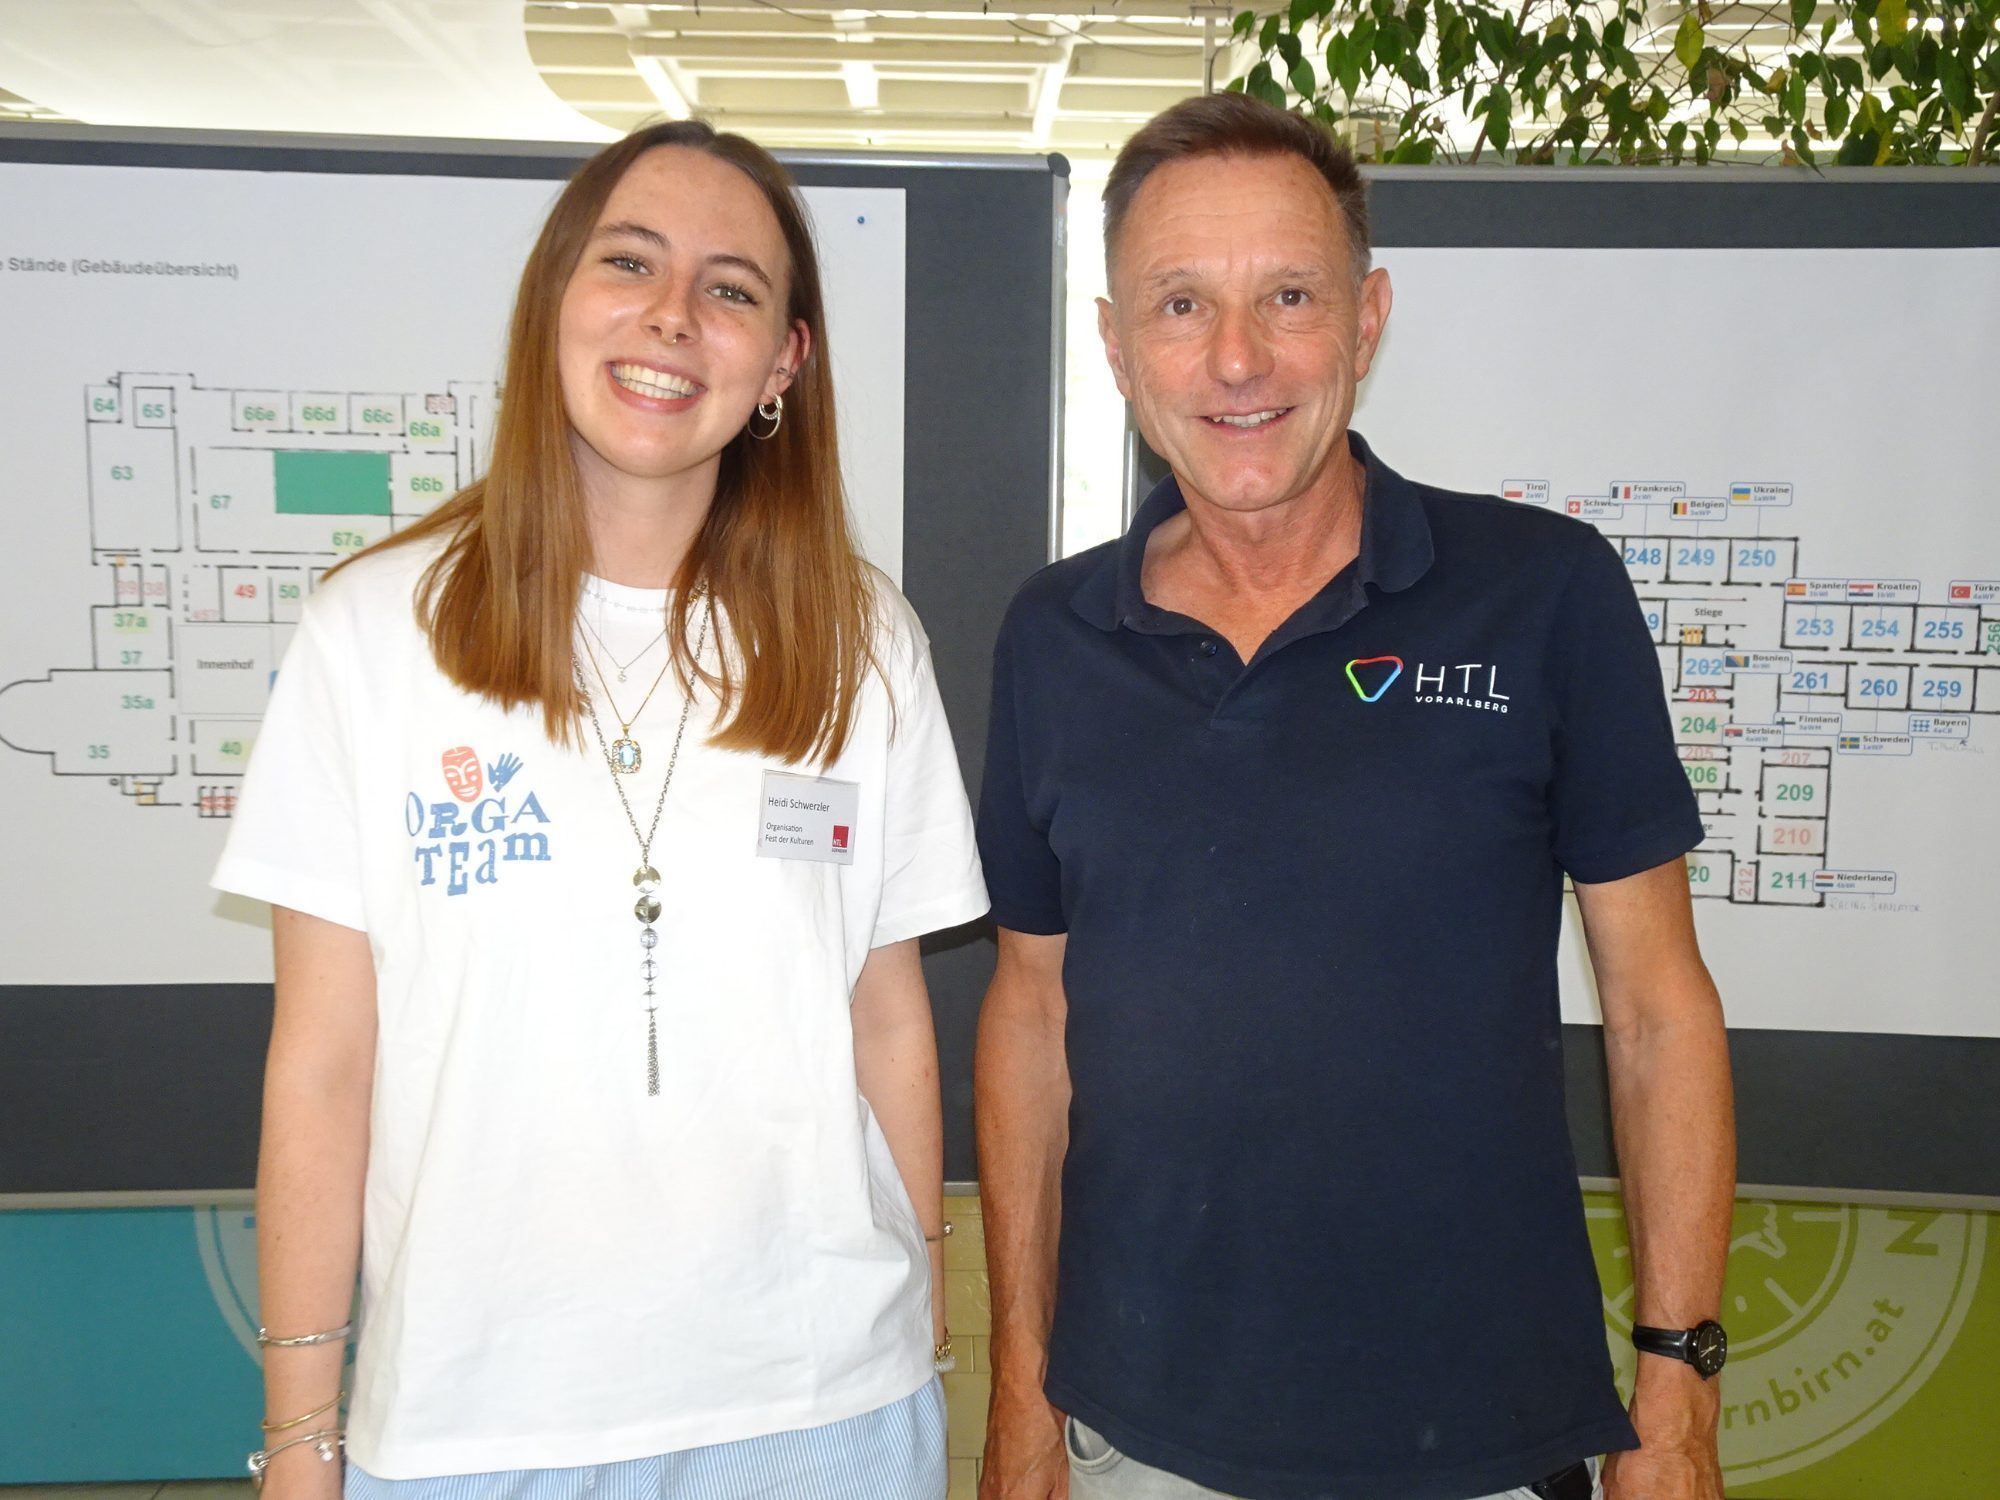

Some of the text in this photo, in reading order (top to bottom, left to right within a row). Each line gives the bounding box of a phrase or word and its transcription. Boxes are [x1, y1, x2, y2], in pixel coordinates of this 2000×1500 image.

[8, 257, 67, 273] Stände
[71, 259, 240, 281] (Gebäudeübersicht)
[93, 398, 116, 412] 64
[142, 404, 165, 418] 65
[243, 406, 276, 421] 66e
[302, 406, 337, 421] 66d
[362, 409, 394, 423] 66c
[409, 422, 441, 437] 66a
[111, 466, 134, 480] 63
[410, 477, 443, 492] 66b
[1525, 483, 1547, 491] Tirol
[1753, 486, 1790, 494] Ukraine
[210, 495, 232, 509] 67
[1690, 500, 1725, 509] Belgien
[332, 532, 364, 547] 67a
[1625, 548, 1662, 565] 248
[1677, 548, 1716, 566] 249
[1738, 549, 1776, 567] 250
[234, 584, 257, 599] 49
[278, 584, 301, 599] 50
[1877, 583, 1918, 591] Kroatien
[1694, 608, 1723, 617] Stiege
[114, 613, 148, 628] 37a
[1795, 618, 1834, 636] 253
[1861, 619, 1899, 637] 254
[1923, 621, 1963, 638] 255
[121, 651, 142, 665] 37
[1752, 654, 1790, 662] Bosnien
[1685, 658, 1723, 676] 202
[1416, 663, 1510, 700] HTL
[1792, 672, 1829, 689] 261
[1860, 679, 1898, 696] 260
[1688, 688, 1717, 703] 203
[1922, 681, 1962, 698] 259
[121, 695, 155, 710] 35a
[1415, 695, 1508, 713] VORARLBERG
[1680, 716, 1718, 733] 204
[1799, 716, 1840, 724] Finnland
[1933, 718, 1967, 727] Bayern
[1863, 735, 1910, 744] Schweden
[88, 745, 111, 759] 35
[220, 741, 243, 756] 40
[1781, 752, 1811, 765] 207
[1775, 783, 1814, 801] 209
[768, 796, 830, 812] Heidi Schwerzler
[405, 791, 552, 839] ORGA
[766, 822, 803, 833] Organisation
[765, 834, 814, 846] Fest der Kulturen
[1773, 828, 1812, 845] 210
[1738, 868, 1753, 897] 212
[1771, 871, 1807, 889] 211
[1836, 874, 1894, 882] Niederlande
